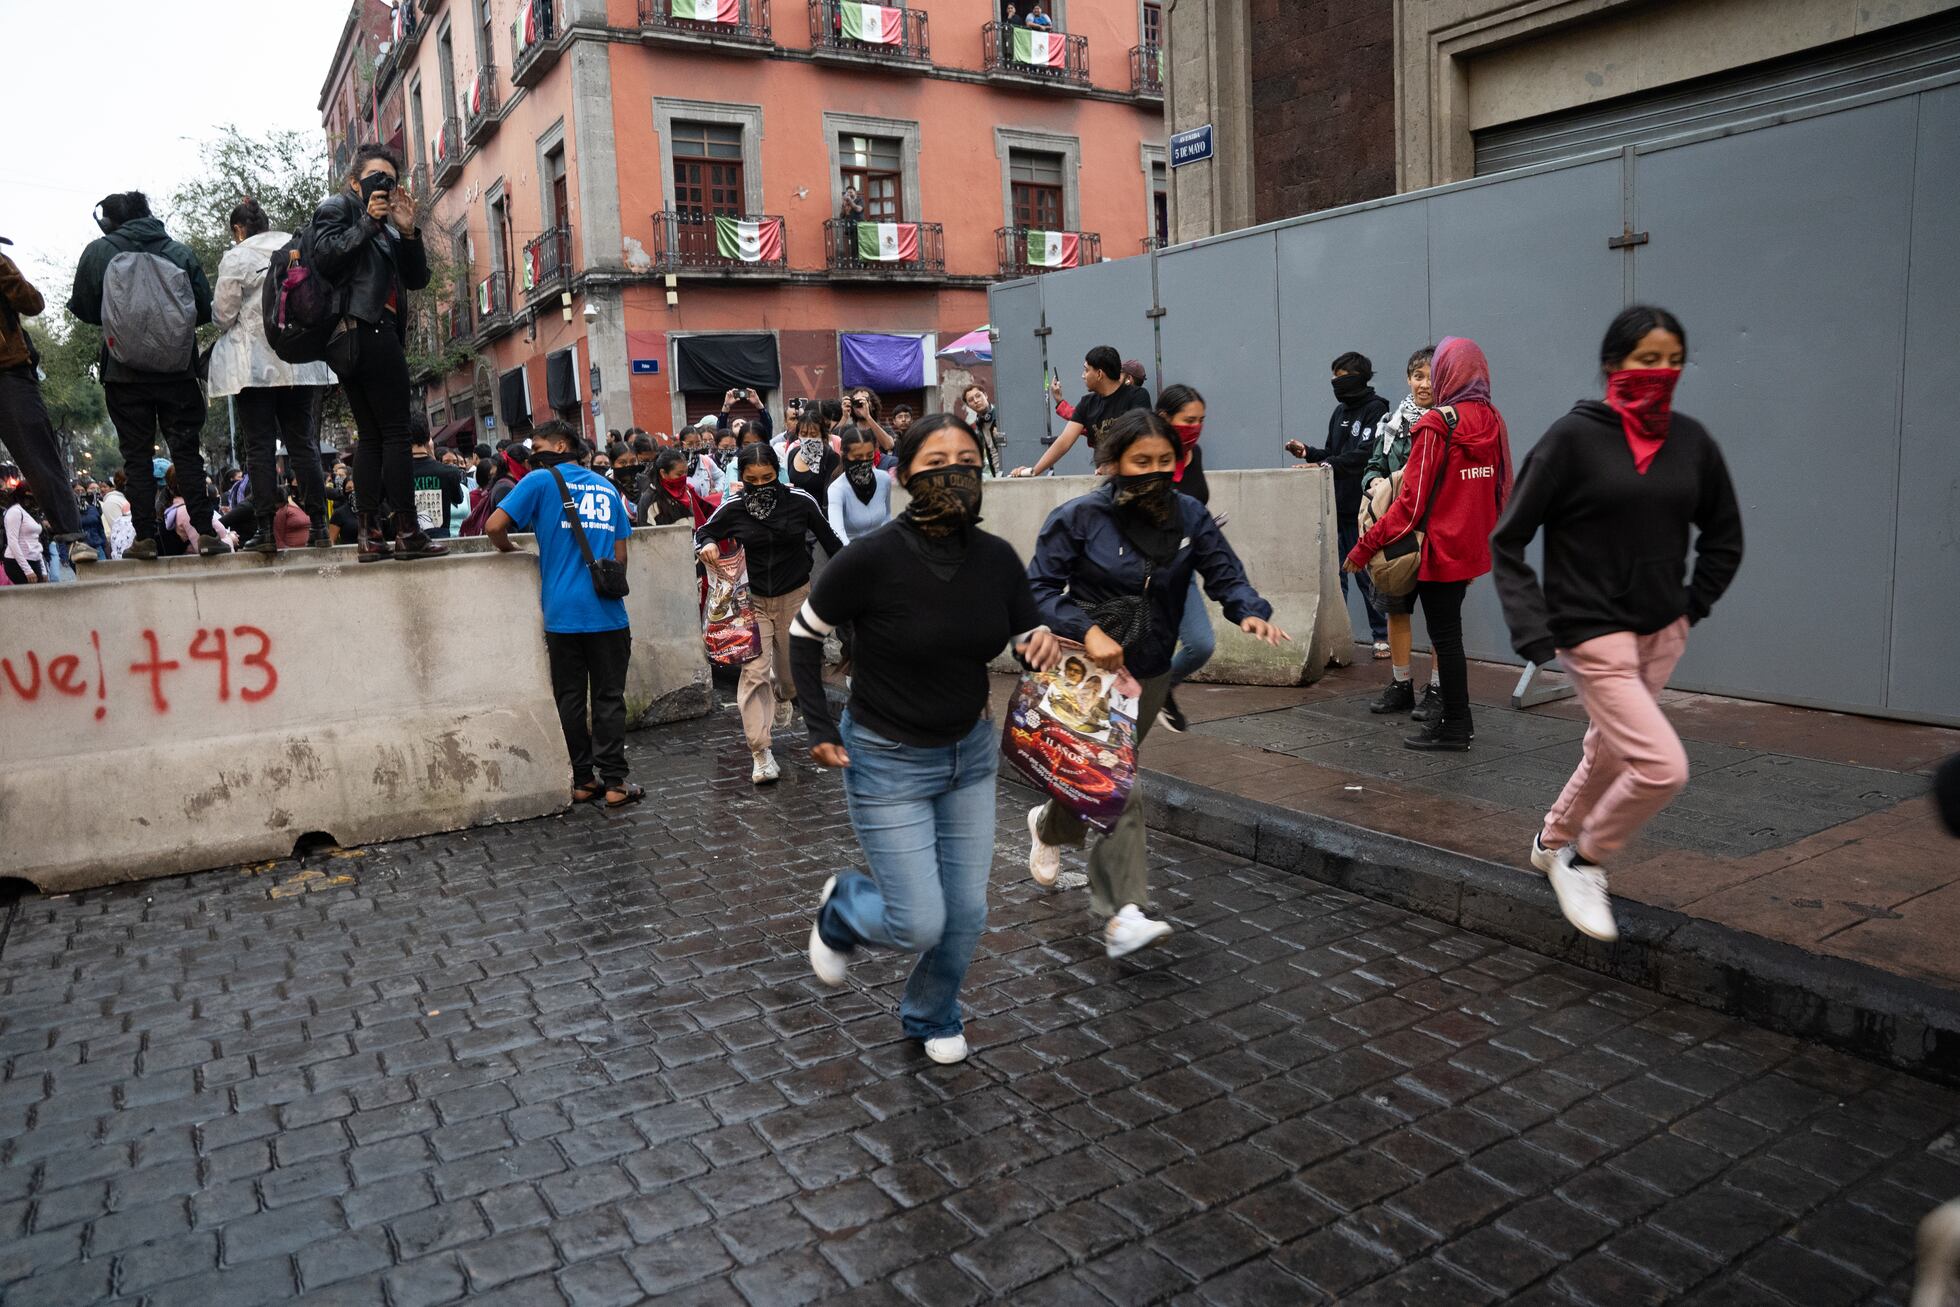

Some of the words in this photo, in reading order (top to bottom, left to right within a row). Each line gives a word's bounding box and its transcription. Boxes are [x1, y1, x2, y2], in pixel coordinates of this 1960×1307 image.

[1174, 149, 1180, 159] 5
[1180, 146, 1188, 158] DE
[1188, 141, 1206, 156] MAYO
[414, 476, 440, 490] XICO
[0, 629, 107, 721] ve!
